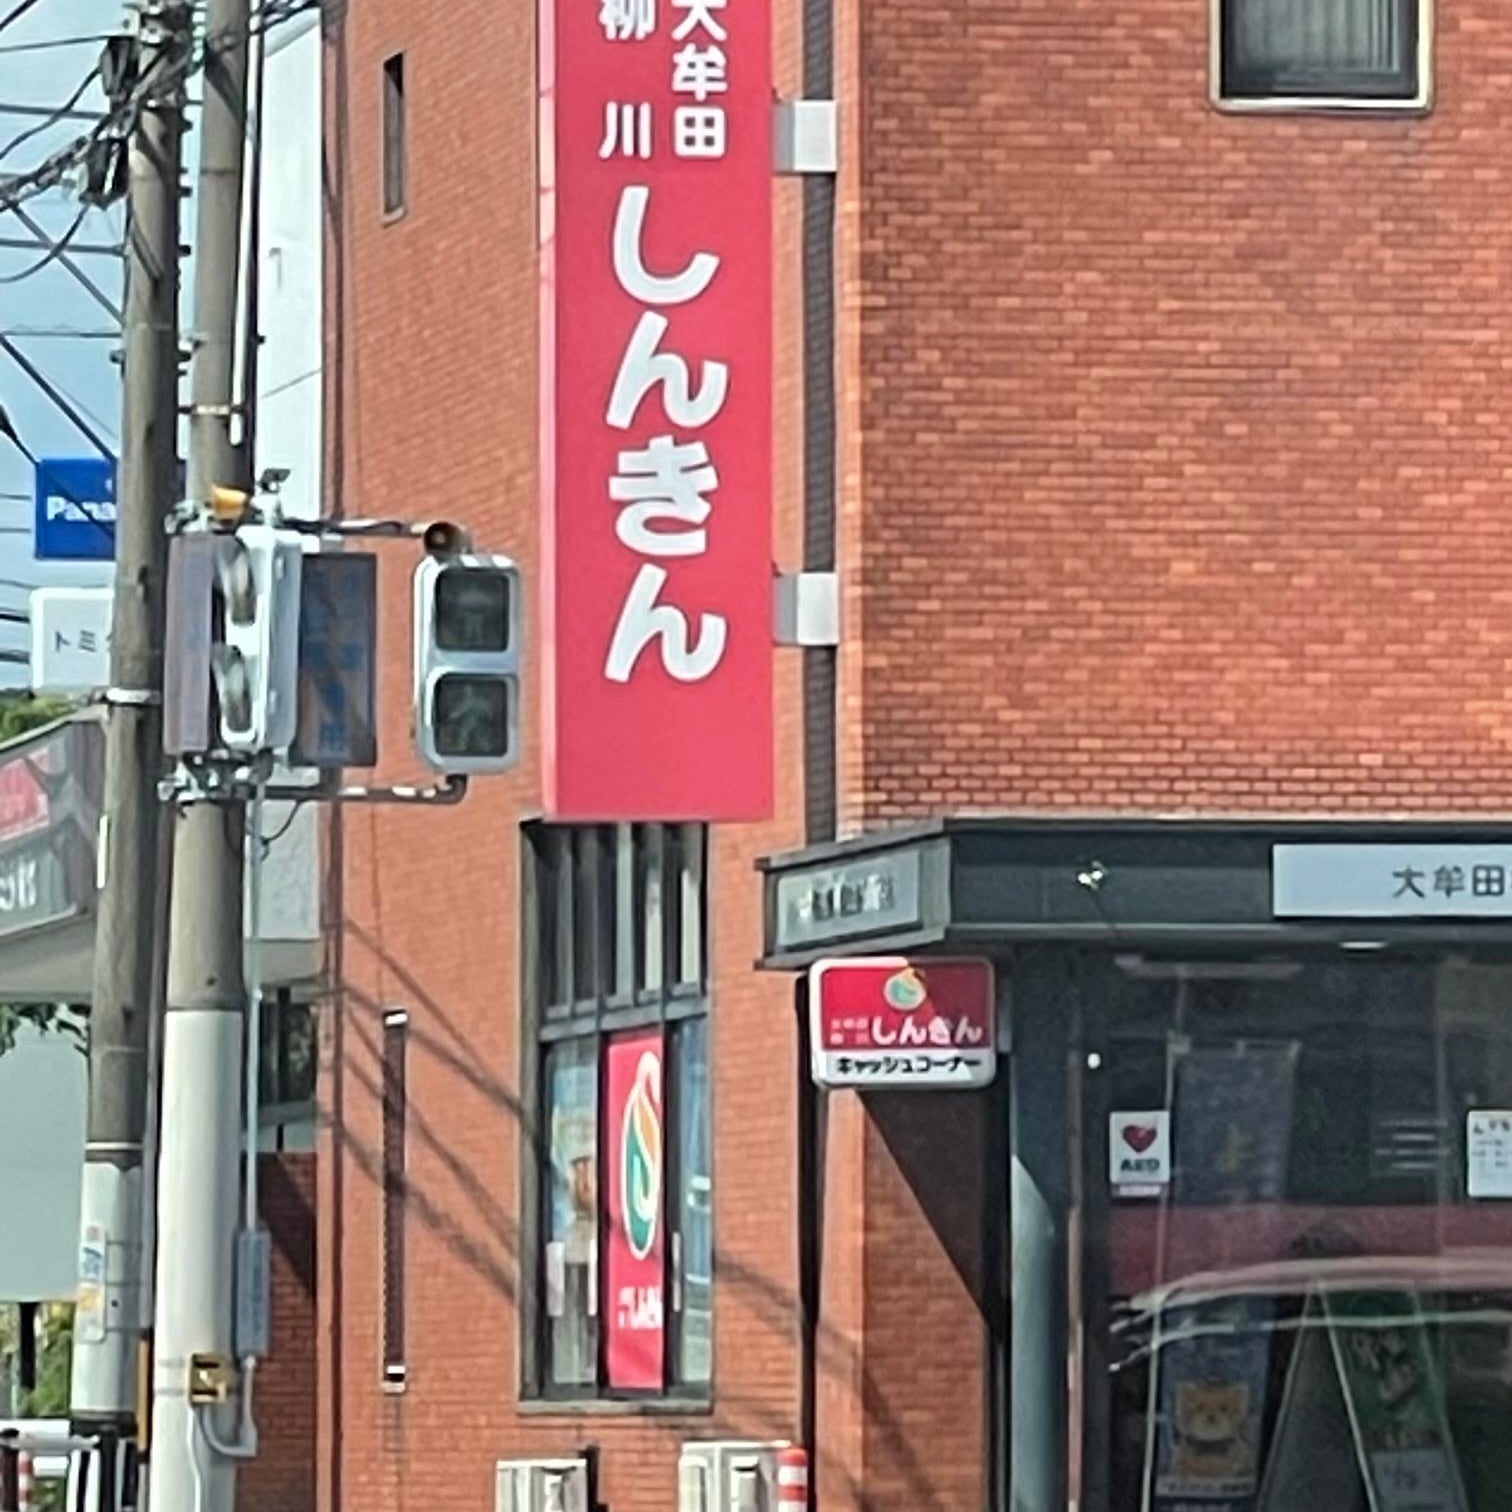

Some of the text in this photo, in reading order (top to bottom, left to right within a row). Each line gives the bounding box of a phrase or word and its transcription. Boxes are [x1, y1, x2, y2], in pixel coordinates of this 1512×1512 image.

[605, 186, 728, 684] しんきん
[872, 1016, 984, 1046] しんきん
[837, 1056, 982, 1074] キャッシュコーナー
